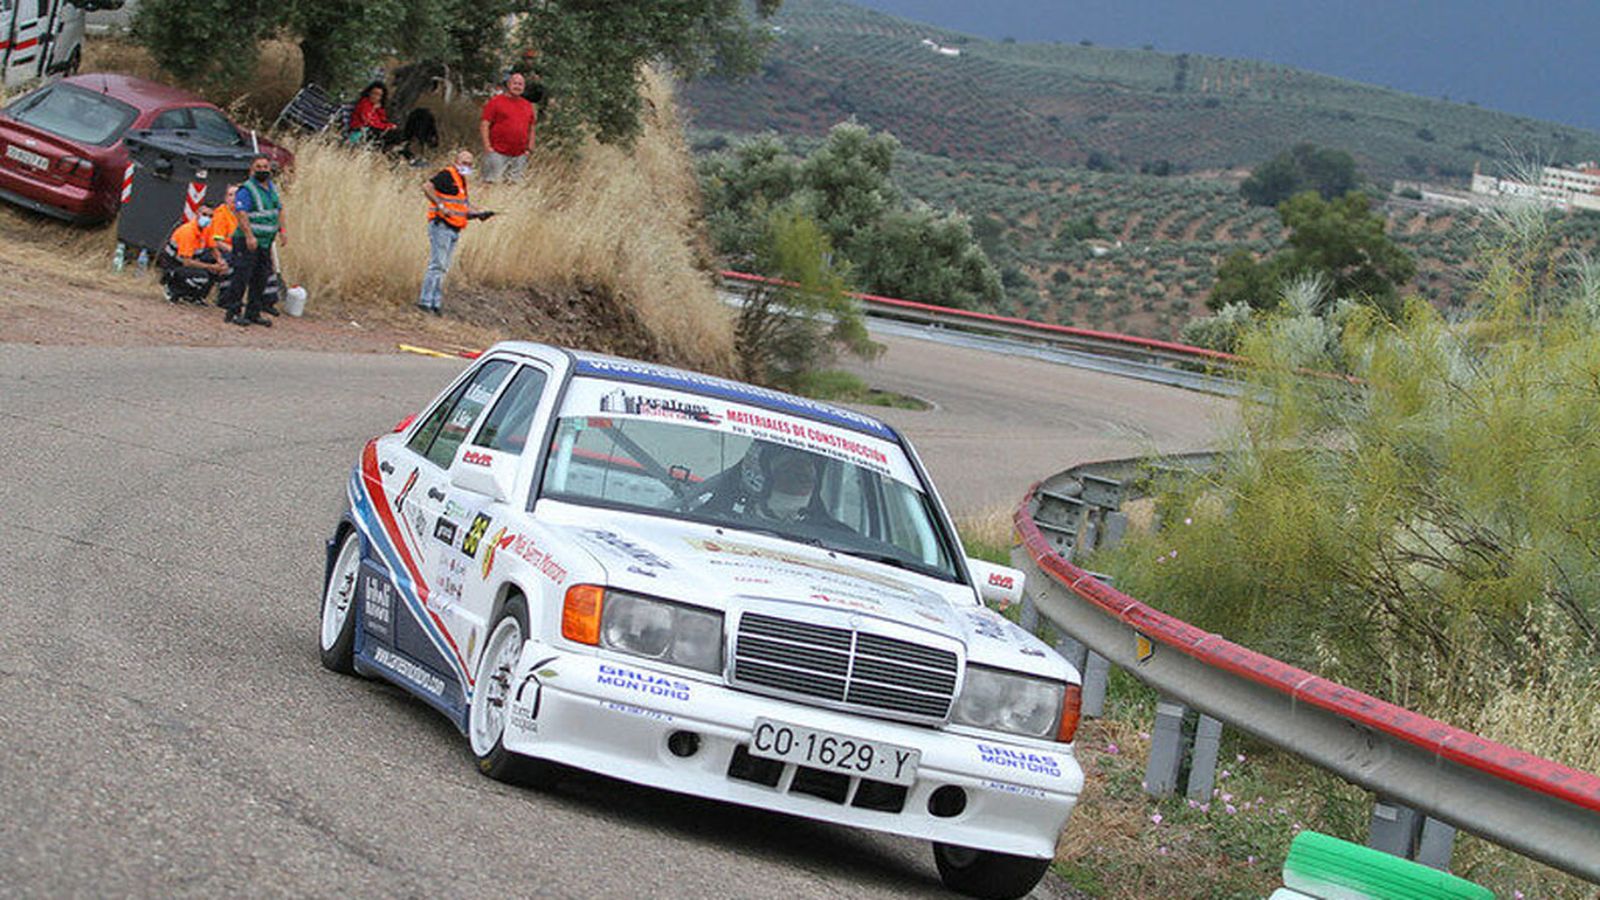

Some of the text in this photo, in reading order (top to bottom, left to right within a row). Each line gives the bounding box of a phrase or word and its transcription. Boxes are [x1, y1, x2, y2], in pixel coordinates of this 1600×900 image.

[726, 409, 793, 434] MATERIALES
[793, 424, 807, 439] DE
[807, 427, 889, 465] CONSTRUCCIÓN
[597, 675, 691, 701] MONTORO
[599, 664, 691, 692] GRUAS
[976, 743, 1058, 767] GRUAS
[981, 754, 1062, 777] MONTORO
